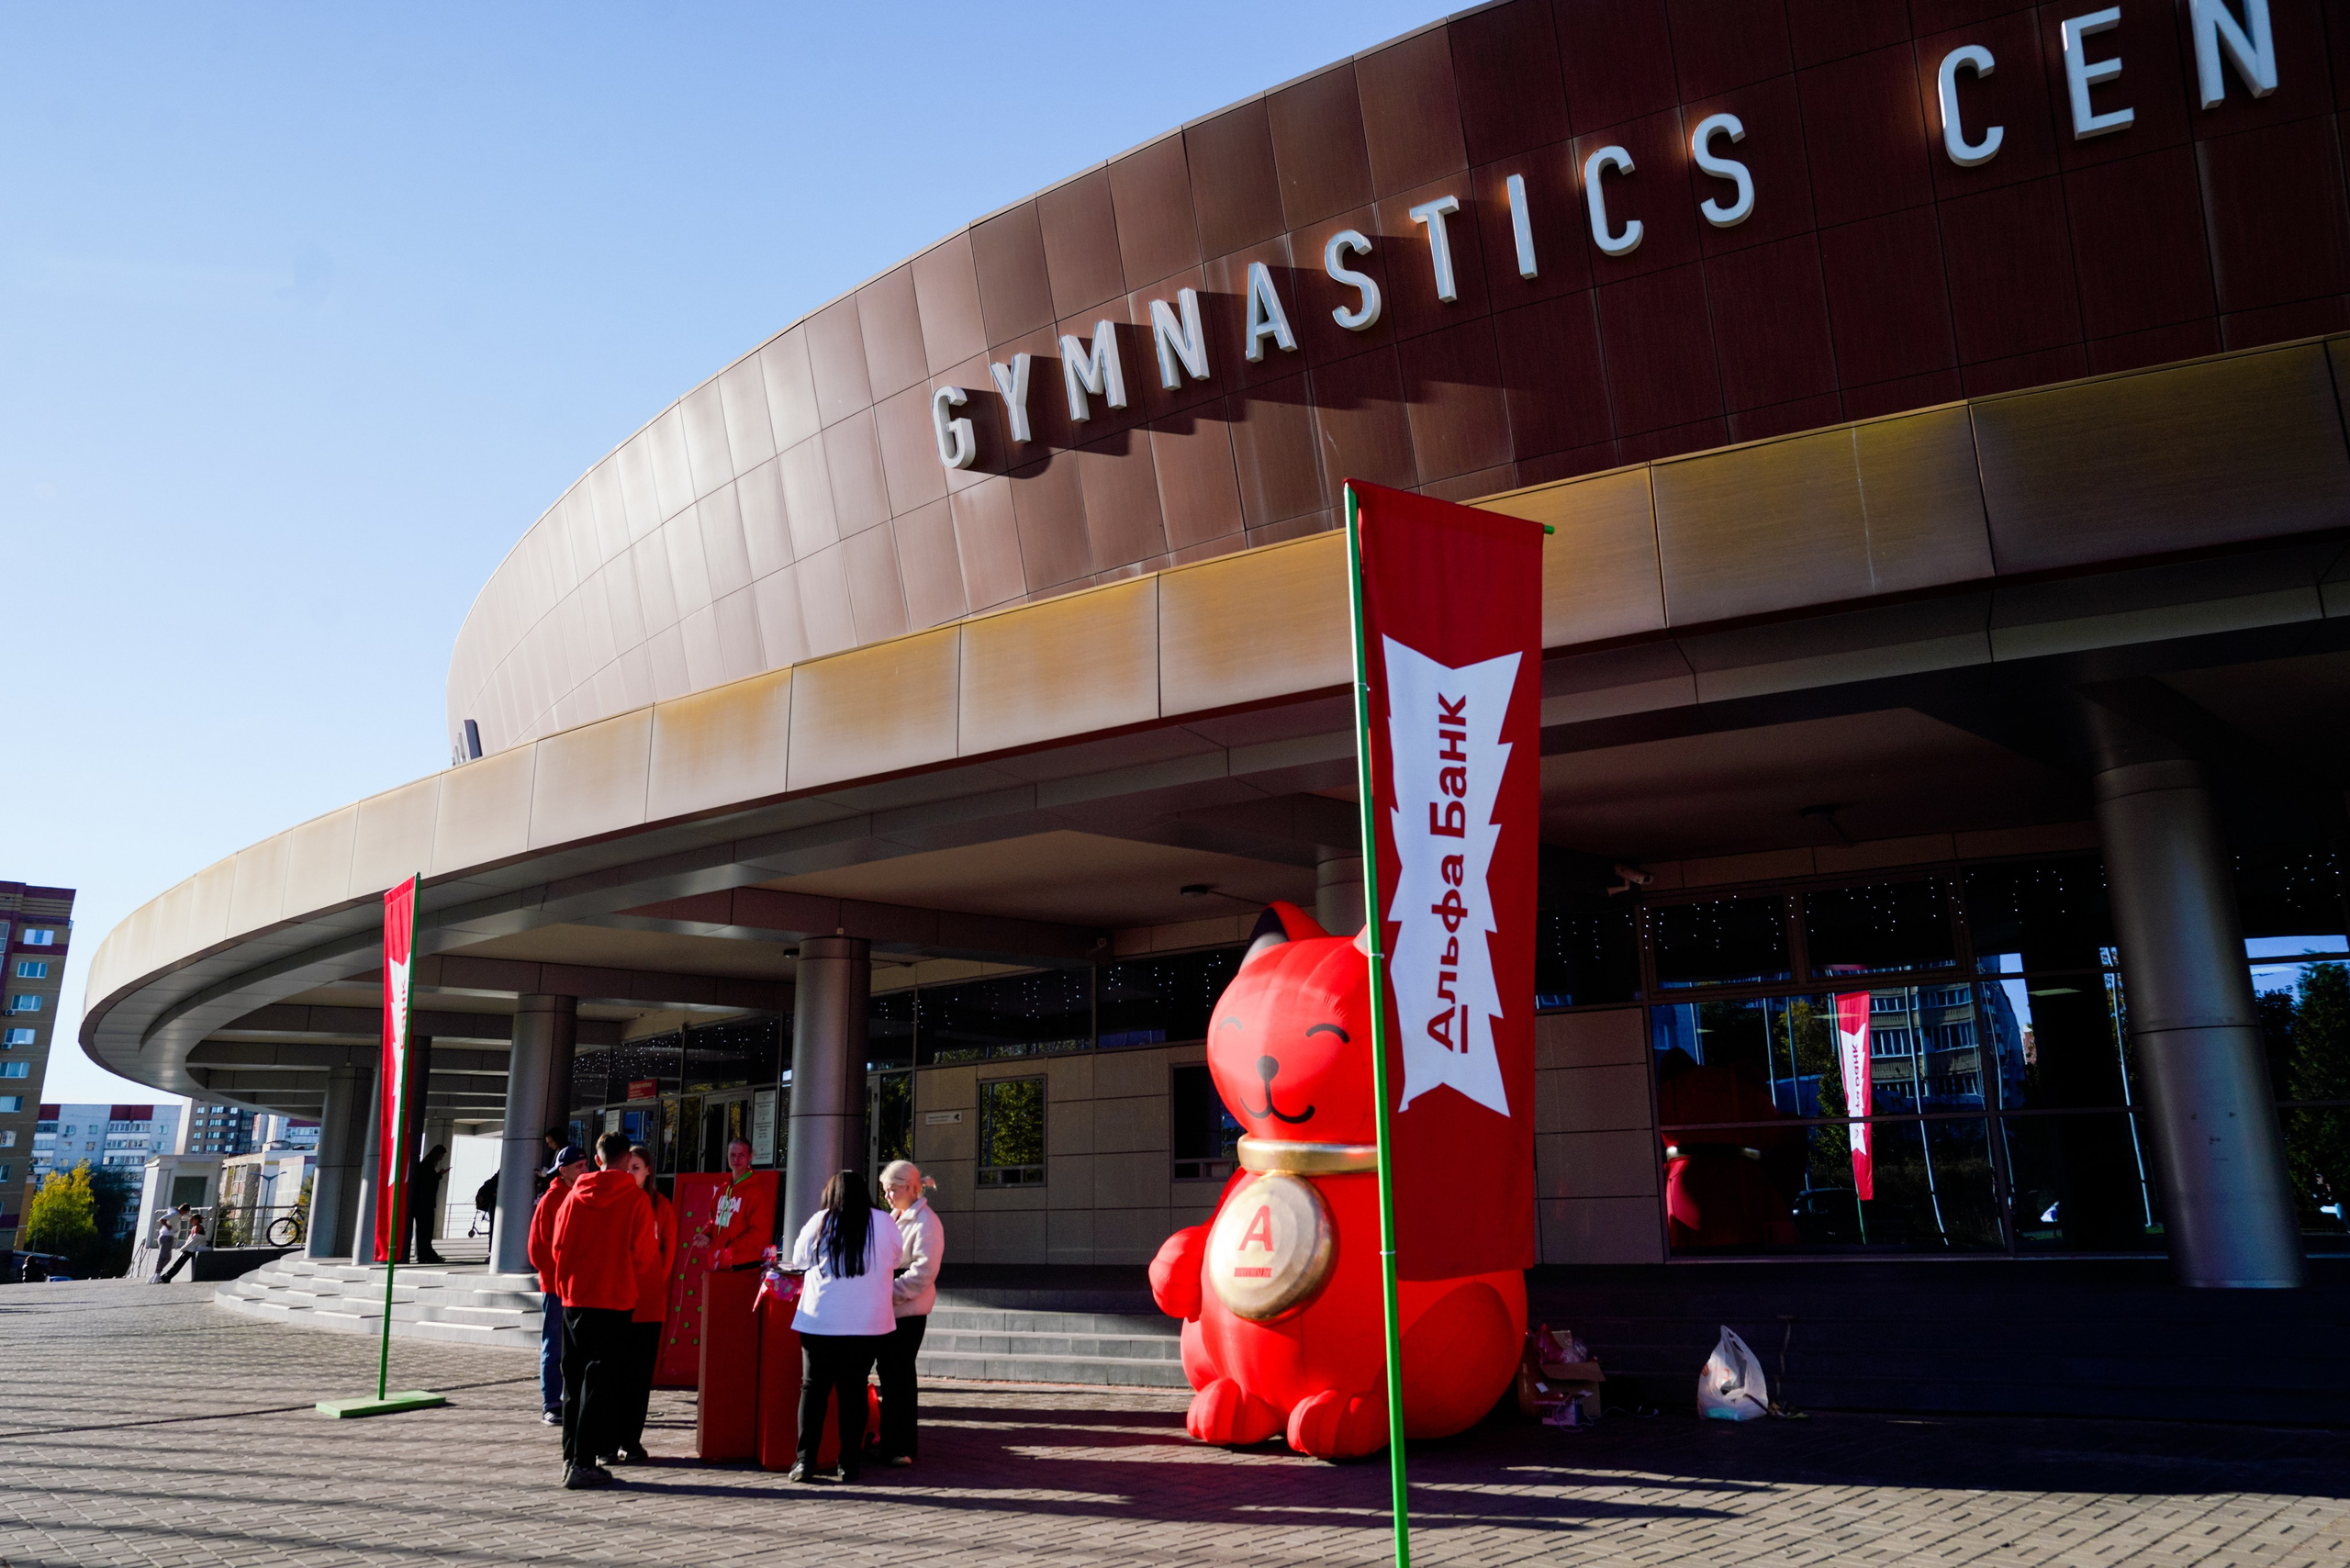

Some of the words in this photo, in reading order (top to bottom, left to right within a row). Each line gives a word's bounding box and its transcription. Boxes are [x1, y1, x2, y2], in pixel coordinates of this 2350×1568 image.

[931, 112, 1756, 470] GYMNASTICS
[1936, 0, 2280, 168] CEN
[1428, 691, 1467, 839] Банк
[1427, 854, 1468, 1054] Альфа
